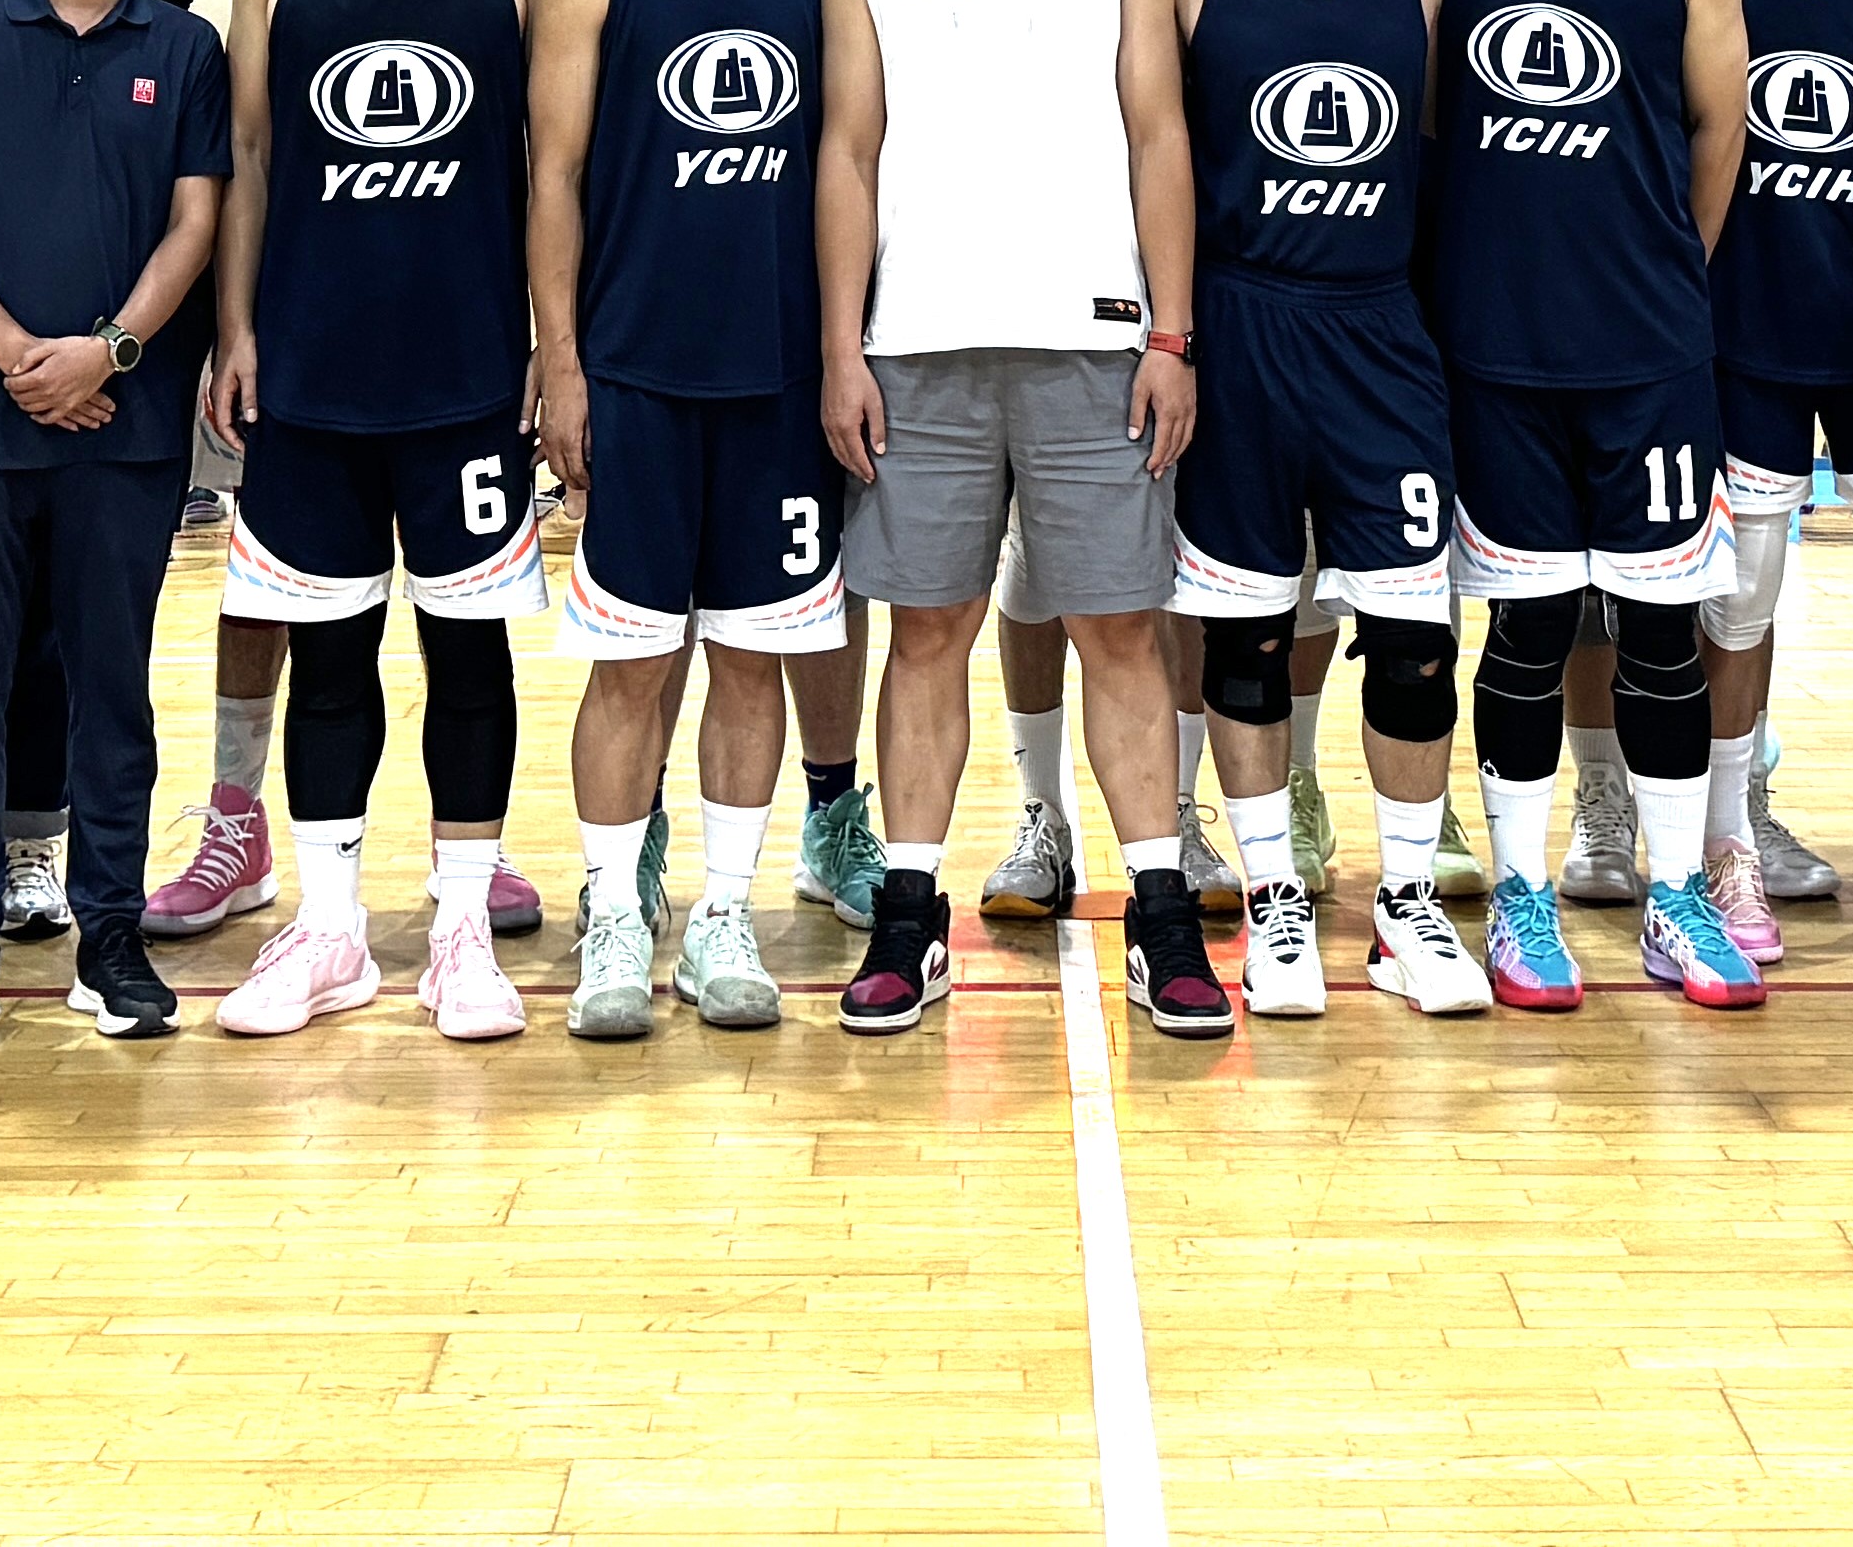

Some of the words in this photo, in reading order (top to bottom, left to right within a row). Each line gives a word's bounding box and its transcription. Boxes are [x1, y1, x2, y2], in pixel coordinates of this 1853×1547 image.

[674, 145, 788, 188] YCIH
[1480, 115, 1611, 159] YCIH
[321, 160, 461, 202] YCIH
[1260, 179, 1387, 217] YCIH
[460, 454, 507, 535] 6
[1399, 472, 1440, 548] 9
[1644, 444, 1697, 523] 11
[781, 496, 821, 576] 3
